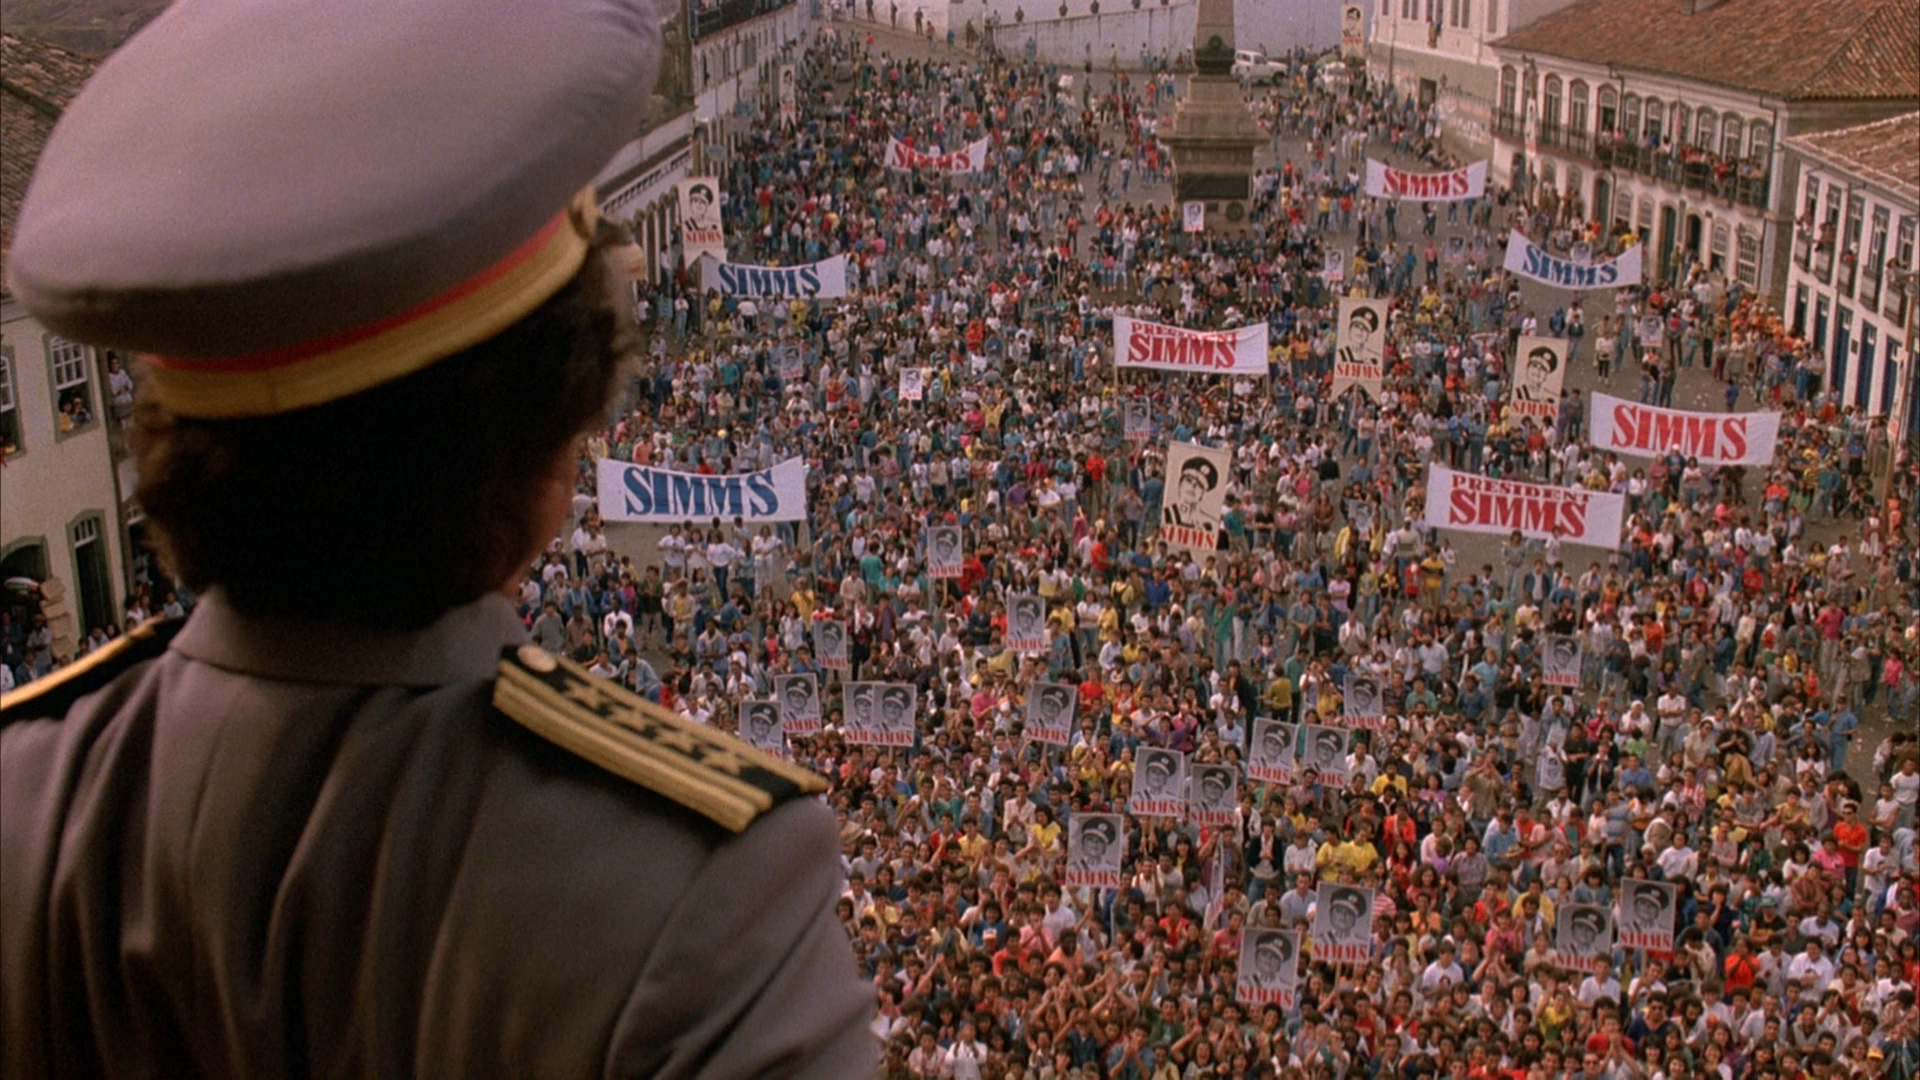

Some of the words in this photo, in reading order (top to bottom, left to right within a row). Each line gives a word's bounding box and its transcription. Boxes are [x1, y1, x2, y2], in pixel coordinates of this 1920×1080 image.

[1383, 167, 1468, 197] SIMMS
[686, 231, 722, 243] SIMMS
[1522, 244, 1618, 286] SIMMS
[719, 263, 821, 298] SIMMS
[1127, 334, 1237, 369] SIMMS
[1336, 363, 1381, 379] SIMMS
[1512, 401, 1557, 417] SIMMS
[1611, 404, 1747, 461] SIMMS
[623, 466, 778, 516] SIMMS
[1452, 474, 1589, 502] PRESIDENT
[1449, 489, 1588, 538] SIMMS
[1160, 526, 1215, 548] SIMMS
[1543, 672, 1578, 684] SIMMS
[871, 732, 912, 743] SIMMS
[1026, 727, 1067, 743] SIMMS
[1248, 767, 1289, 782] SIMMS
[1067, 871, 1118, 885] SIMMS
[1620, 931, 1671, 948] SIMMS
[1313, 943, 1367, 960] SIMMS
[1238, 985, 1292, 1007] SIMMS
